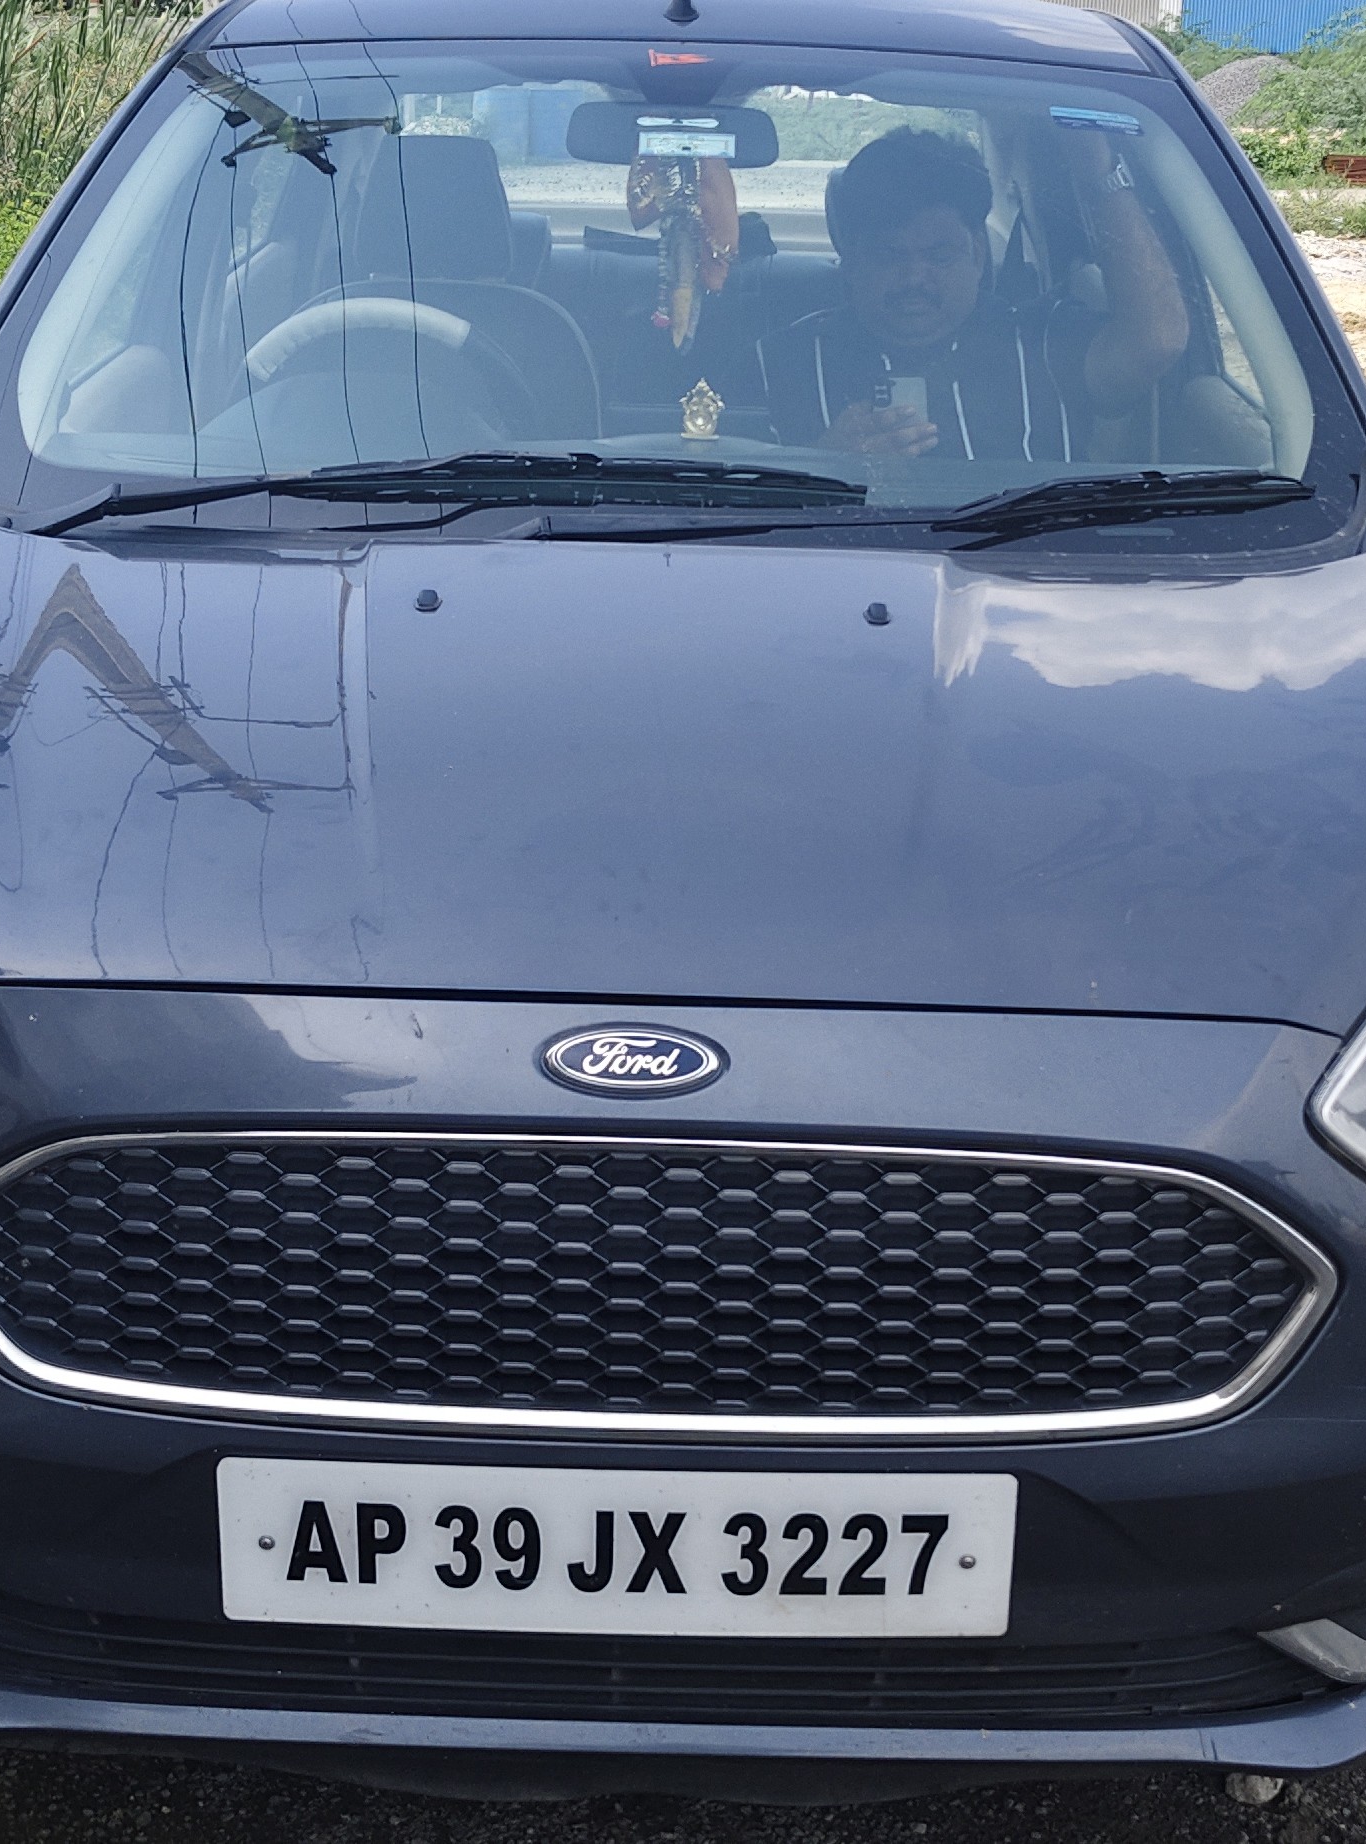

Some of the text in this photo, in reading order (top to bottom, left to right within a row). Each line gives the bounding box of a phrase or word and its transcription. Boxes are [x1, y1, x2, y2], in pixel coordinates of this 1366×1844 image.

[581, 1036, 681, 1076] Ford
[285, 1499, 950, 1597] AP 39 JX 3227
